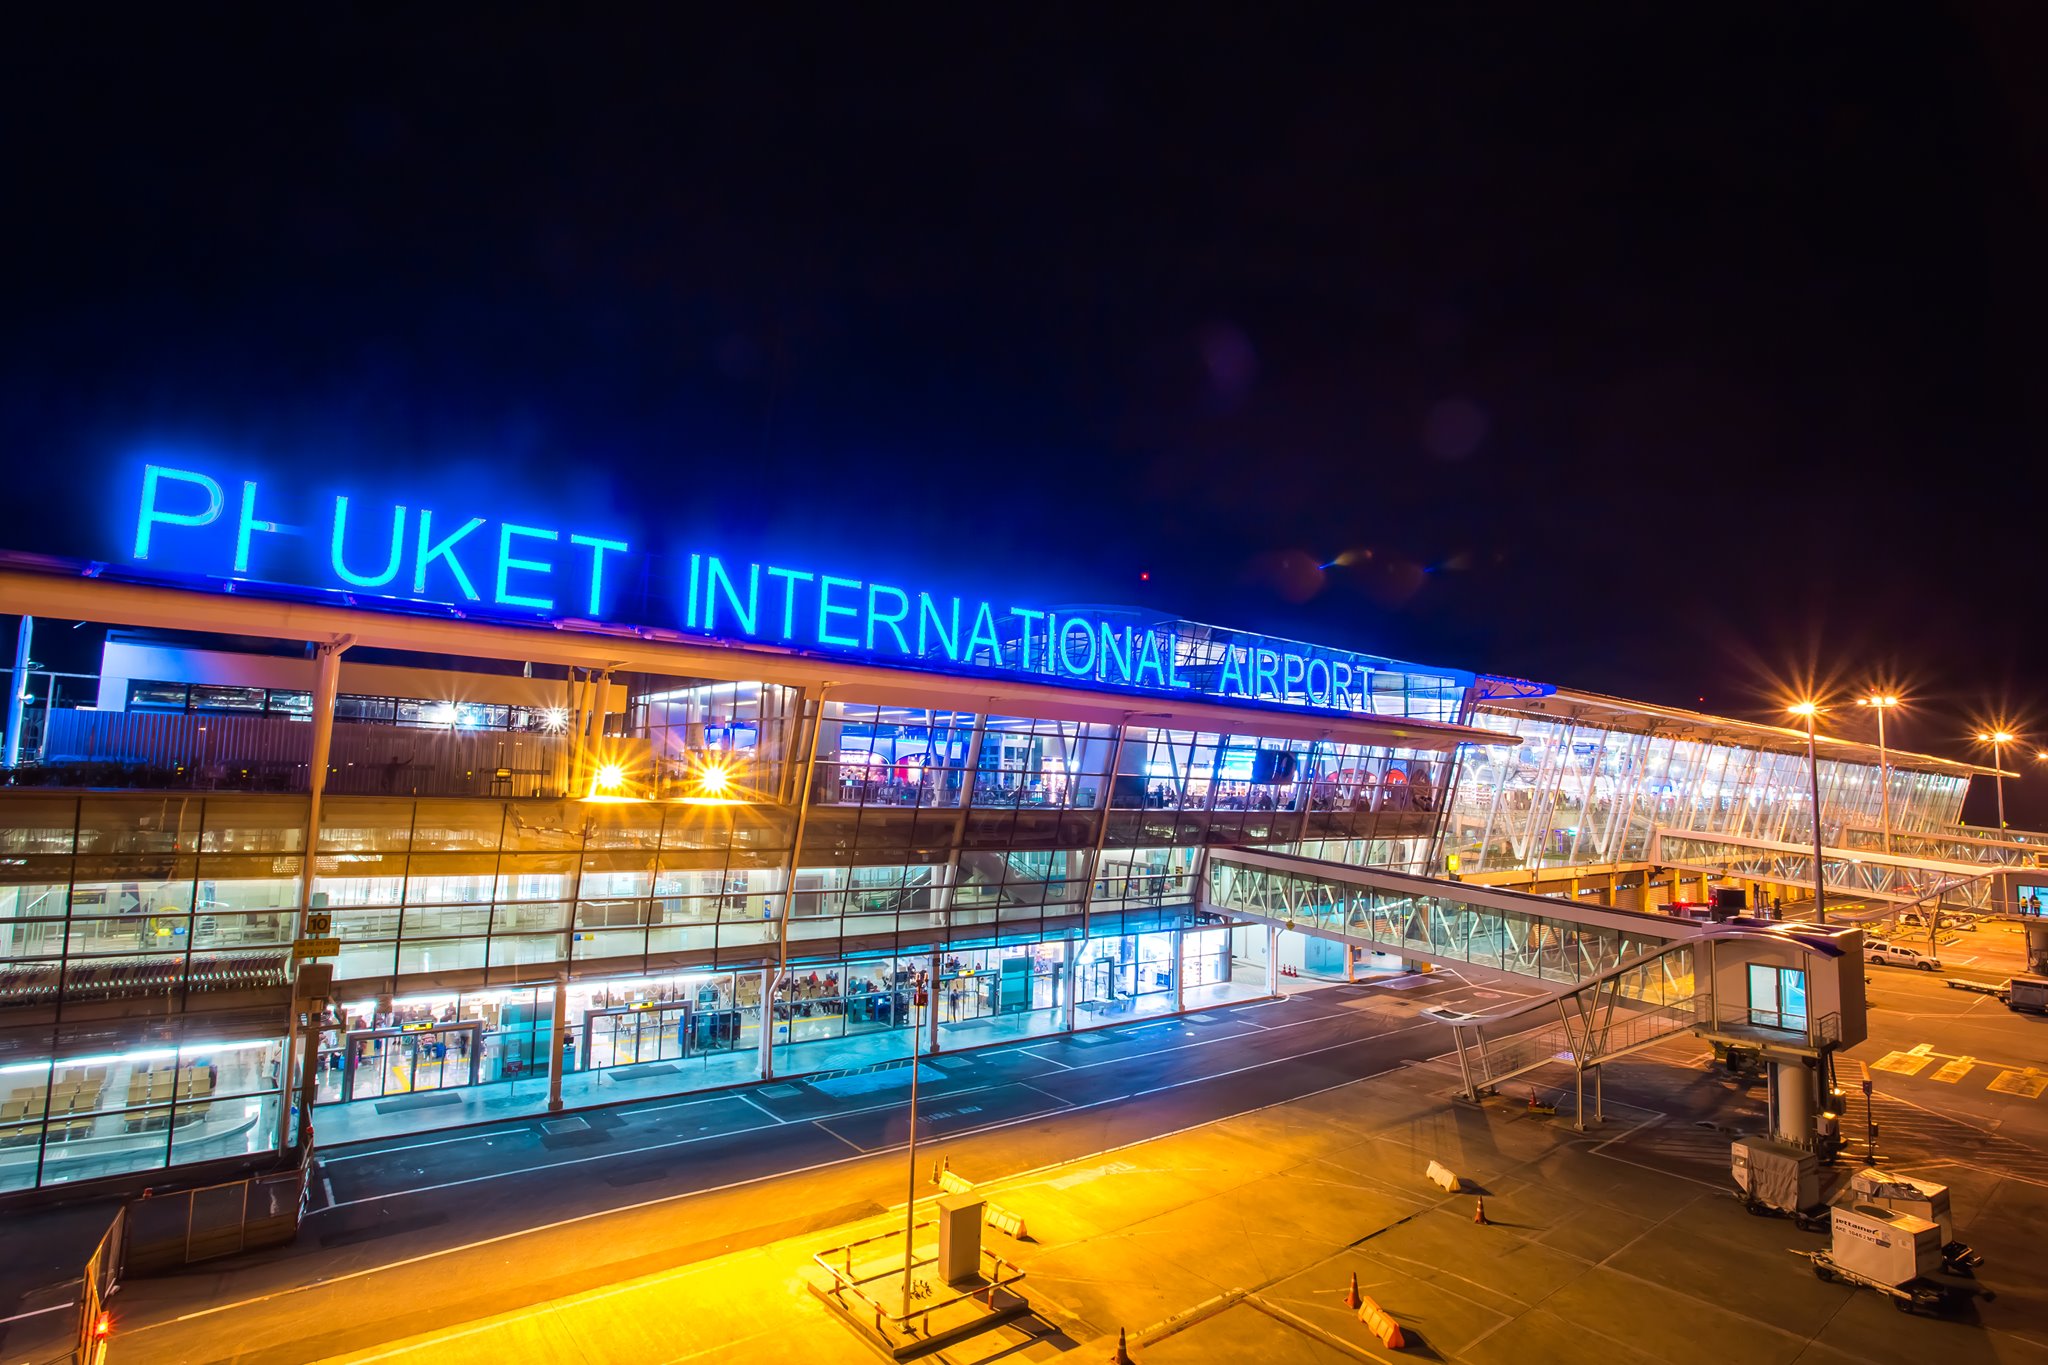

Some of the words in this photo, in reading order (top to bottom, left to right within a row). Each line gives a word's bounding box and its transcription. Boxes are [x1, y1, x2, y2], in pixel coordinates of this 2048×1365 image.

[686, 553, 1191, 689] INTERNATIONAL
[1218, 643, 1376, 711] AIRPORT
[311, 918, 328, 930] 10
